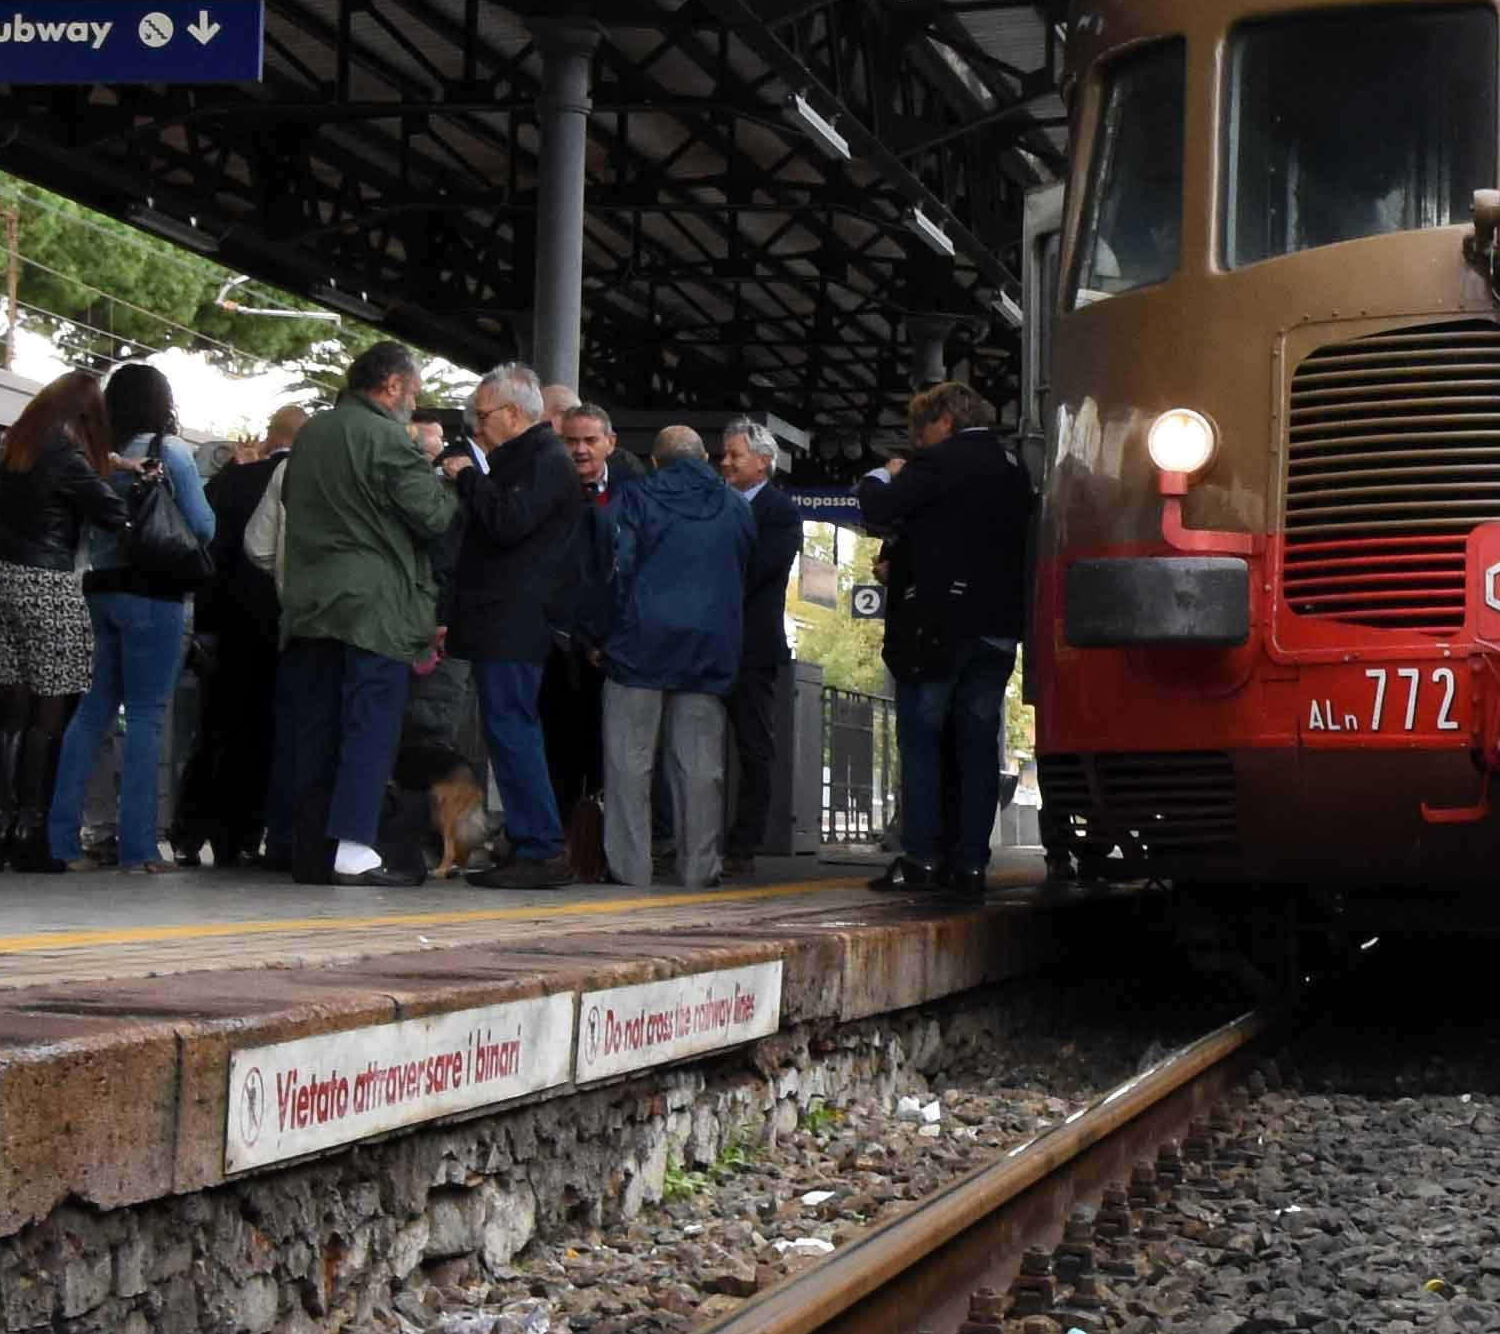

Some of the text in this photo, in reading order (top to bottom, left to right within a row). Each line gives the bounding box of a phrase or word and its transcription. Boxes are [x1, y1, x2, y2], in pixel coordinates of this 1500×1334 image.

[861, 593, 875, 610] 2
[1309, 699, 1359, 731] ALn
[1365, 667, 1460, 731] 772
[604, 1009, 622, 1056] Do
[625, 1008, 645, 1050] not
[647, 1008, 674, 1046] cross
[733, 981, 756, 1025] lines
[276, 1022, 522, 1132] Vietato attraversare i binari
